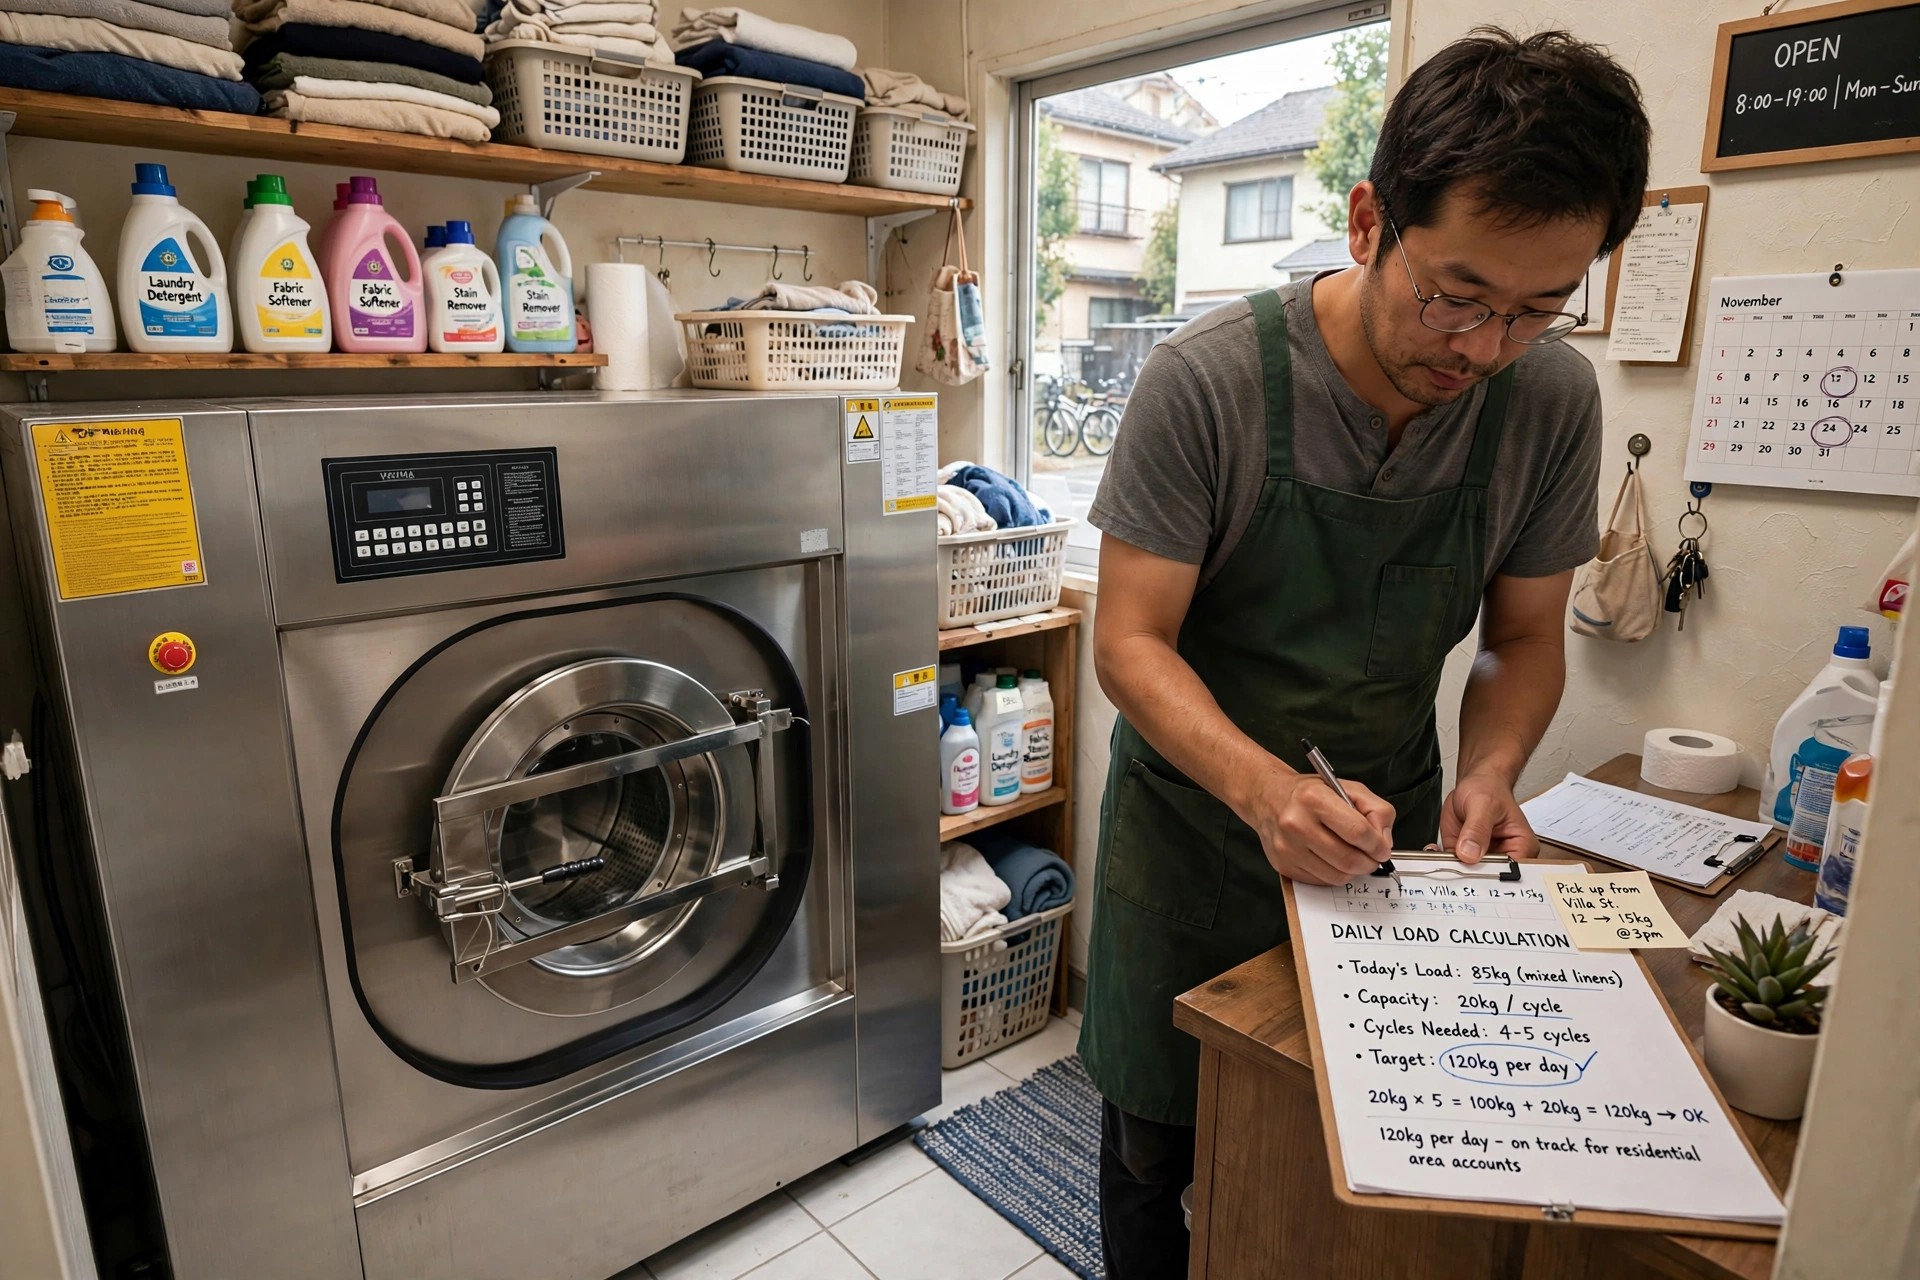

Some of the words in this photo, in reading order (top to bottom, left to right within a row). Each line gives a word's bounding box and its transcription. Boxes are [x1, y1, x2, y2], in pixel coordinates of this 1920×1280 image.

[1774, 34, 1841, 68] OPEN
[149, 275, 194, 291] Laundry
[273, 281, 304, 293] Fabric
[362, 283, 392, 295] Fabric
[147, 289, 203, 305] Detergent
[454, 287, 478, 298] Stain
[526, 289, 550, 301] Stain
[268, 294, 312, 307] Softener
[359, 295, 401, 308] Softener
[447, 300, 487, 311] Remover
[522, 302, 561, 313] Remover
[1721, 294, 1782, 307] November
[1909, 322, 1915, 332] 1
[1721, 349, 1725, 358] 1
[1747, 348, 1754, 358] 2
[1776, 348, 1783, 358] 3
[1806, 348, 1813, 358] 4
[1837, 348, 1845, 358] 4
[1869, 348, 1877, 358] 6
[1903, 348, 1911, 358] 8
[1716, 372, 1724, 381] 6
[1802, 373, 1810, 383] 9
[1863, 374, 1876, 384] 12
[1897, 374, 1910, 384] 15
[1739, 397, 1750, 405] 14
[1767, 398, 1779, 407] 15
[1796, 398, 1810, 408] 16
[1827, 399, 1841, 409] 16
[1859, 399, 1872, 409] 17
[1892, 400, 1906, 410] 18
[1706, 419, 1718, 428] 21
[1733, 420, 1745, 429] 21
[1761, 421, 1775, 430] 22
[1791, 422, 1806, 432] 23
[1822, 423, 1837, 433] 24
[1853, 424, 1868, 434] 24
[1886, 425, 1902, 435] 25
[1702, 442, 1716, 451] 29
[1730, 443, 1743, 452] 29
[1758, 445, 1772, 454] 20
[1787, 446, 1802, 456] 30
[1818, 448, 1831, 457] 31
[1345, 883, 1370, 895] Pick
[1377, 888, 1391, 899] up
[1429, 885, 1458, 897] Villa
[1464, 888, 1480, 897] St.
[1489, 889, 1500, 897] 12
[1520, 891, 1545, 903] 15kg
[1556, 882, 1585, 894] Pick
[1589, 886, 1605, 896] up
[1610, 882, 1641, 894] from
[1562, 897, 1596, 909] Villa
[1599, 898, 1620, 909] St.
[1571, 913, 1588, 923] 12
[1618, 911, 1653, 928] 15kg
[1331, 923, 1383, 940] DAILY
[1393, 926, 1440, 942] LOAD
[1450, 929, 1570, 948] CALCULATION
[1349, 959, 1408, 981] Today's
[1415, 962, 1462, 978] Load:
[1472, 965, 1511, 986] 85kg
[1517, 966, 1568, 983] (mixed
[1574, 969, 1623, 988] linens)
[1358, 989, 1439, 1012] Capacity:
[1458, 994, 1499, 1016] 20kg
[1522, 997, 1563, 1017] cycle
[1363, 1018, 1415, 1039] Cycles
[1421, 1020, 1488, 1038] Needed:
[1499, 1024, 1535, 1040] 4-5
[1543, 1027, 1591, 1047] cycles
[1368, 1048, 1435, 1072] Target:
[1448, 1053, 1499, 1077] 120kg
[1506, 1061, 1531, 1077] per
[1539, 1056, 1569, 1080] day
[1368, 1089, 1407, 1111] 20kg
[1432, 1093, 1443, 1107] 5
[1470, 1095, 1516, 1118] 100kg
[1541, 1099, 1582, 1122] 20kg
[1605, 1104, 1652, 1126] 120kg
[1682, 1108, 1710, 1124] OK
[1380, 1127, 1424, 1149] 120kg
[1430, 1134, 1454, 1149] per
[1461, 1130, 1488, 1152] day
[1511, 1139, 1530, 1150] on
[1536, 1137, 1578, 1153] track
[1584, 1138, 1609, 1155] for
[1616, 1143, 1701, 1162] residential
[1409, 1154, 1445, 1167] area
[1452, 1157, 1521, 1172] accounts
